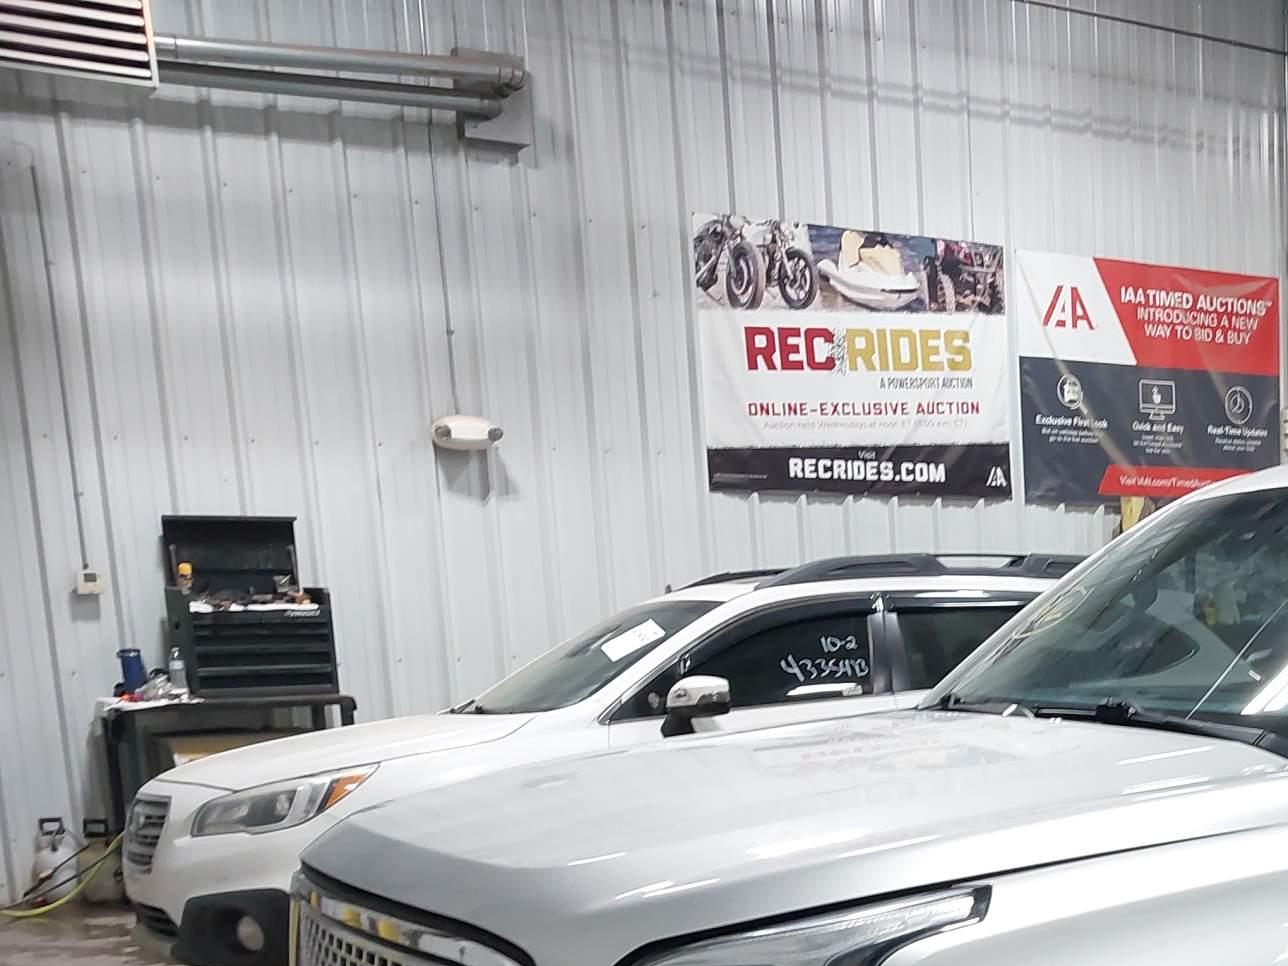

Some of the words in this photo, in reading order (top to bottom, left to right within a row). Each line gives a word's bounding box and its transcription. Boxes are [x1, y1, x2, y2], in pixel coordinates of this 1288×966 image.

[1120, 286, 1145, 304] IAA
[1146, 288, 1193, 309] TIMED
[1138, 307, 1218, 328] INTRODUCING
[1220, 314, 1229, 328] A
[1232, 316, 1258, 330] NEW
[1144, 322, 1173, 338] WAY
[1175, 325, 1192, 340] TO
[1194, 328, 1212, 342] BID
[1215, 330, 1225, 343] &
[1227, 331, 1251, 345] BUY
[744, 326, 836, 371] REC
[845, 328, 972, 372] RIDES
[880, 377, 887, 389] A
[887, 377, 940, 389] POWERSPORT
[942, 377, 974, 389] AUCTION
[748, 401, 909, 416] ONLINE-EXCLUSIVE
[916, 401, 980, 415] AUCTION
[1035, 413, 1073, 426] Exclusive
[1132, 420, 1151, 431] Quick
[1152, 423, 1166, 432] and
[1167, 422, 1184, 435] Easy
[1242, 427, 1268, 438] Updates
[789, 457, 946, 483] RECRIDES.COM
[820, 635, 858, 653] 10-2
